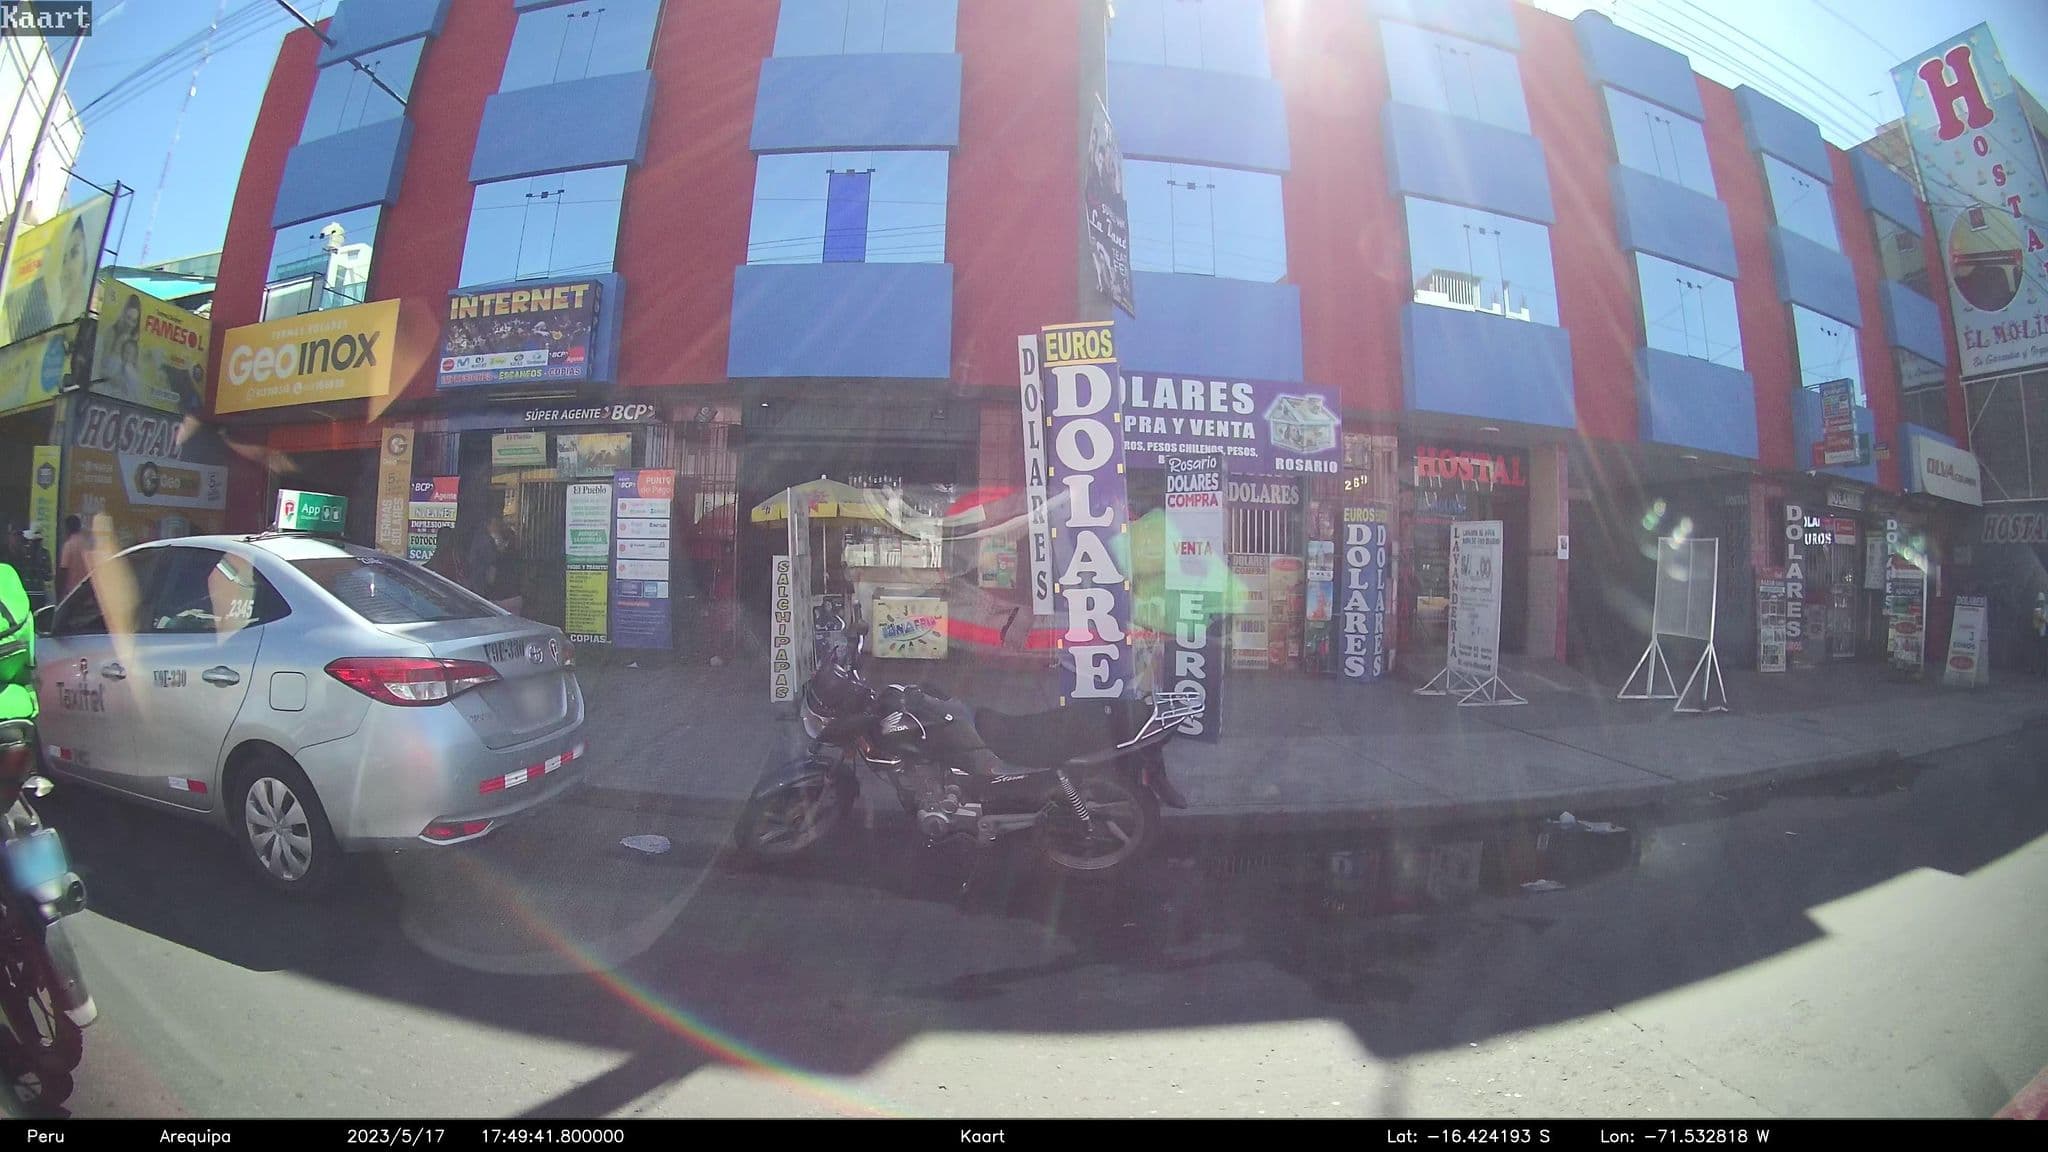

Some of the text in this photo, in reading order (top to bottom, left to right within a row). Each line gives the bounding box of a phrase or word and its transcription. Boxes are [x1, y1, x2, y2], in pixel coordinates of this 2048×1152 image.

[451, 284, 590, 320] INTERNET
[145, 315, 205, 351] FAMESOL
[1045, 329, 1114, 362] EUROS
[524, 404, 648, 422] SÚPER AGENTE BCP
[1172, 417, 1185, 435] Y
[1190, 420, 1256, 440] VENTA
[1148, 441, 1178, 453] PESOS
[1226, 445, 1259, 458] PESOS,
[1168, 456, 1218, 473] Rosario
[1275, 456, 1339, 474] ROSARIO
[1414, 447, 1527, 487] HOSTAL
[1166, 472, 1220, 493] DOLARES
[1166, 492, 1219, 508] COMPRA
[1228, 481, 1300, 505] DOLARES
[301, 503, 321, 516] App
[1343, 507, 1376, 522] EUROS
[1173, 541, 1214, 556] VENTA
[1785, 504, 1803, 638] DOLARES
[229, 599, 255, 618] 2345
[1344, 523, 1373, 679] DOLARES
[570, 634, 606, 644] COPIAS
[773, 560, 791, 699] SALCHIPAPAS
